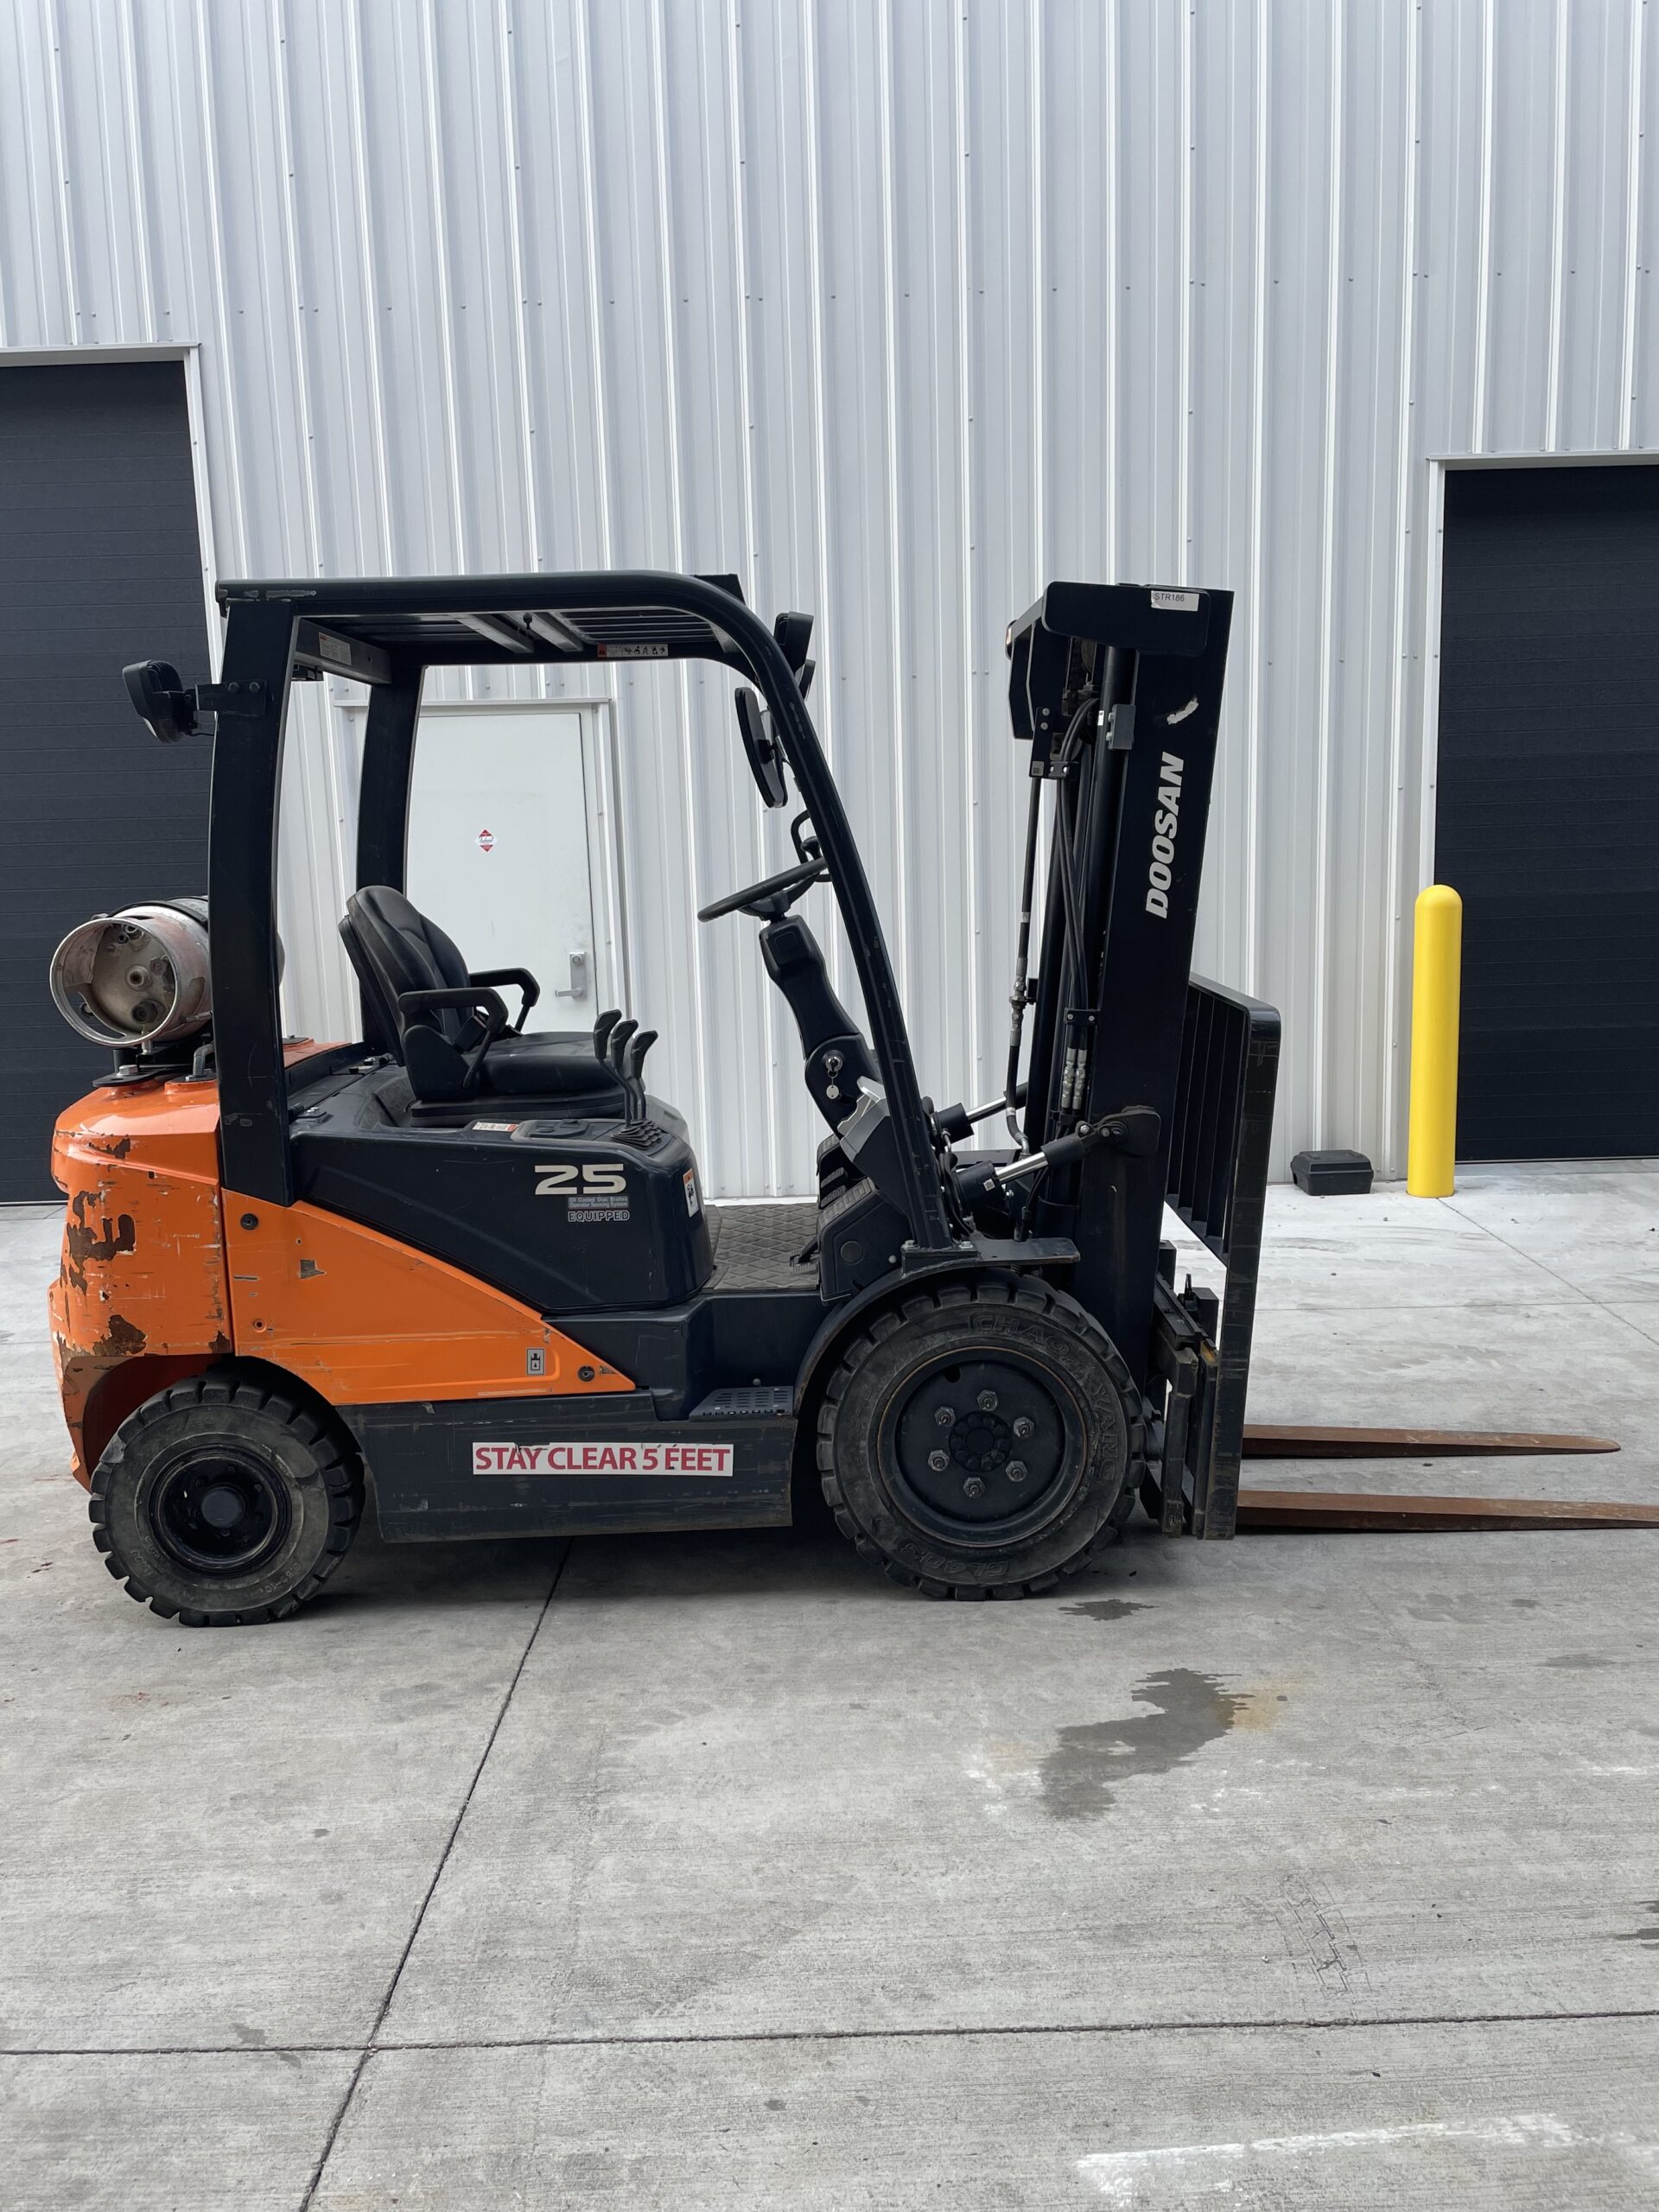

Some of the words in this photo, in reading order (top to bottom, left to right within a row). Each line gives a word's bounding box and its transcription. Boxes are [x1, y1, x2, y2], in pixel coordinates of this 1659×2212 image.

[1154, 593, 1185, 602] STR186
[1146, 751, 1185, 919] DOOSAN
[534, 1163, 627, 1195] 25
[568, 1210, 630, 1223] EQUIPPED
[475, 1447, 543, 1470] STAY
[547, 1447, 637, 1470] CLEAR
[642, 1448, 658, 1470] 5
[664, 1448, 730, 1471] FEET
